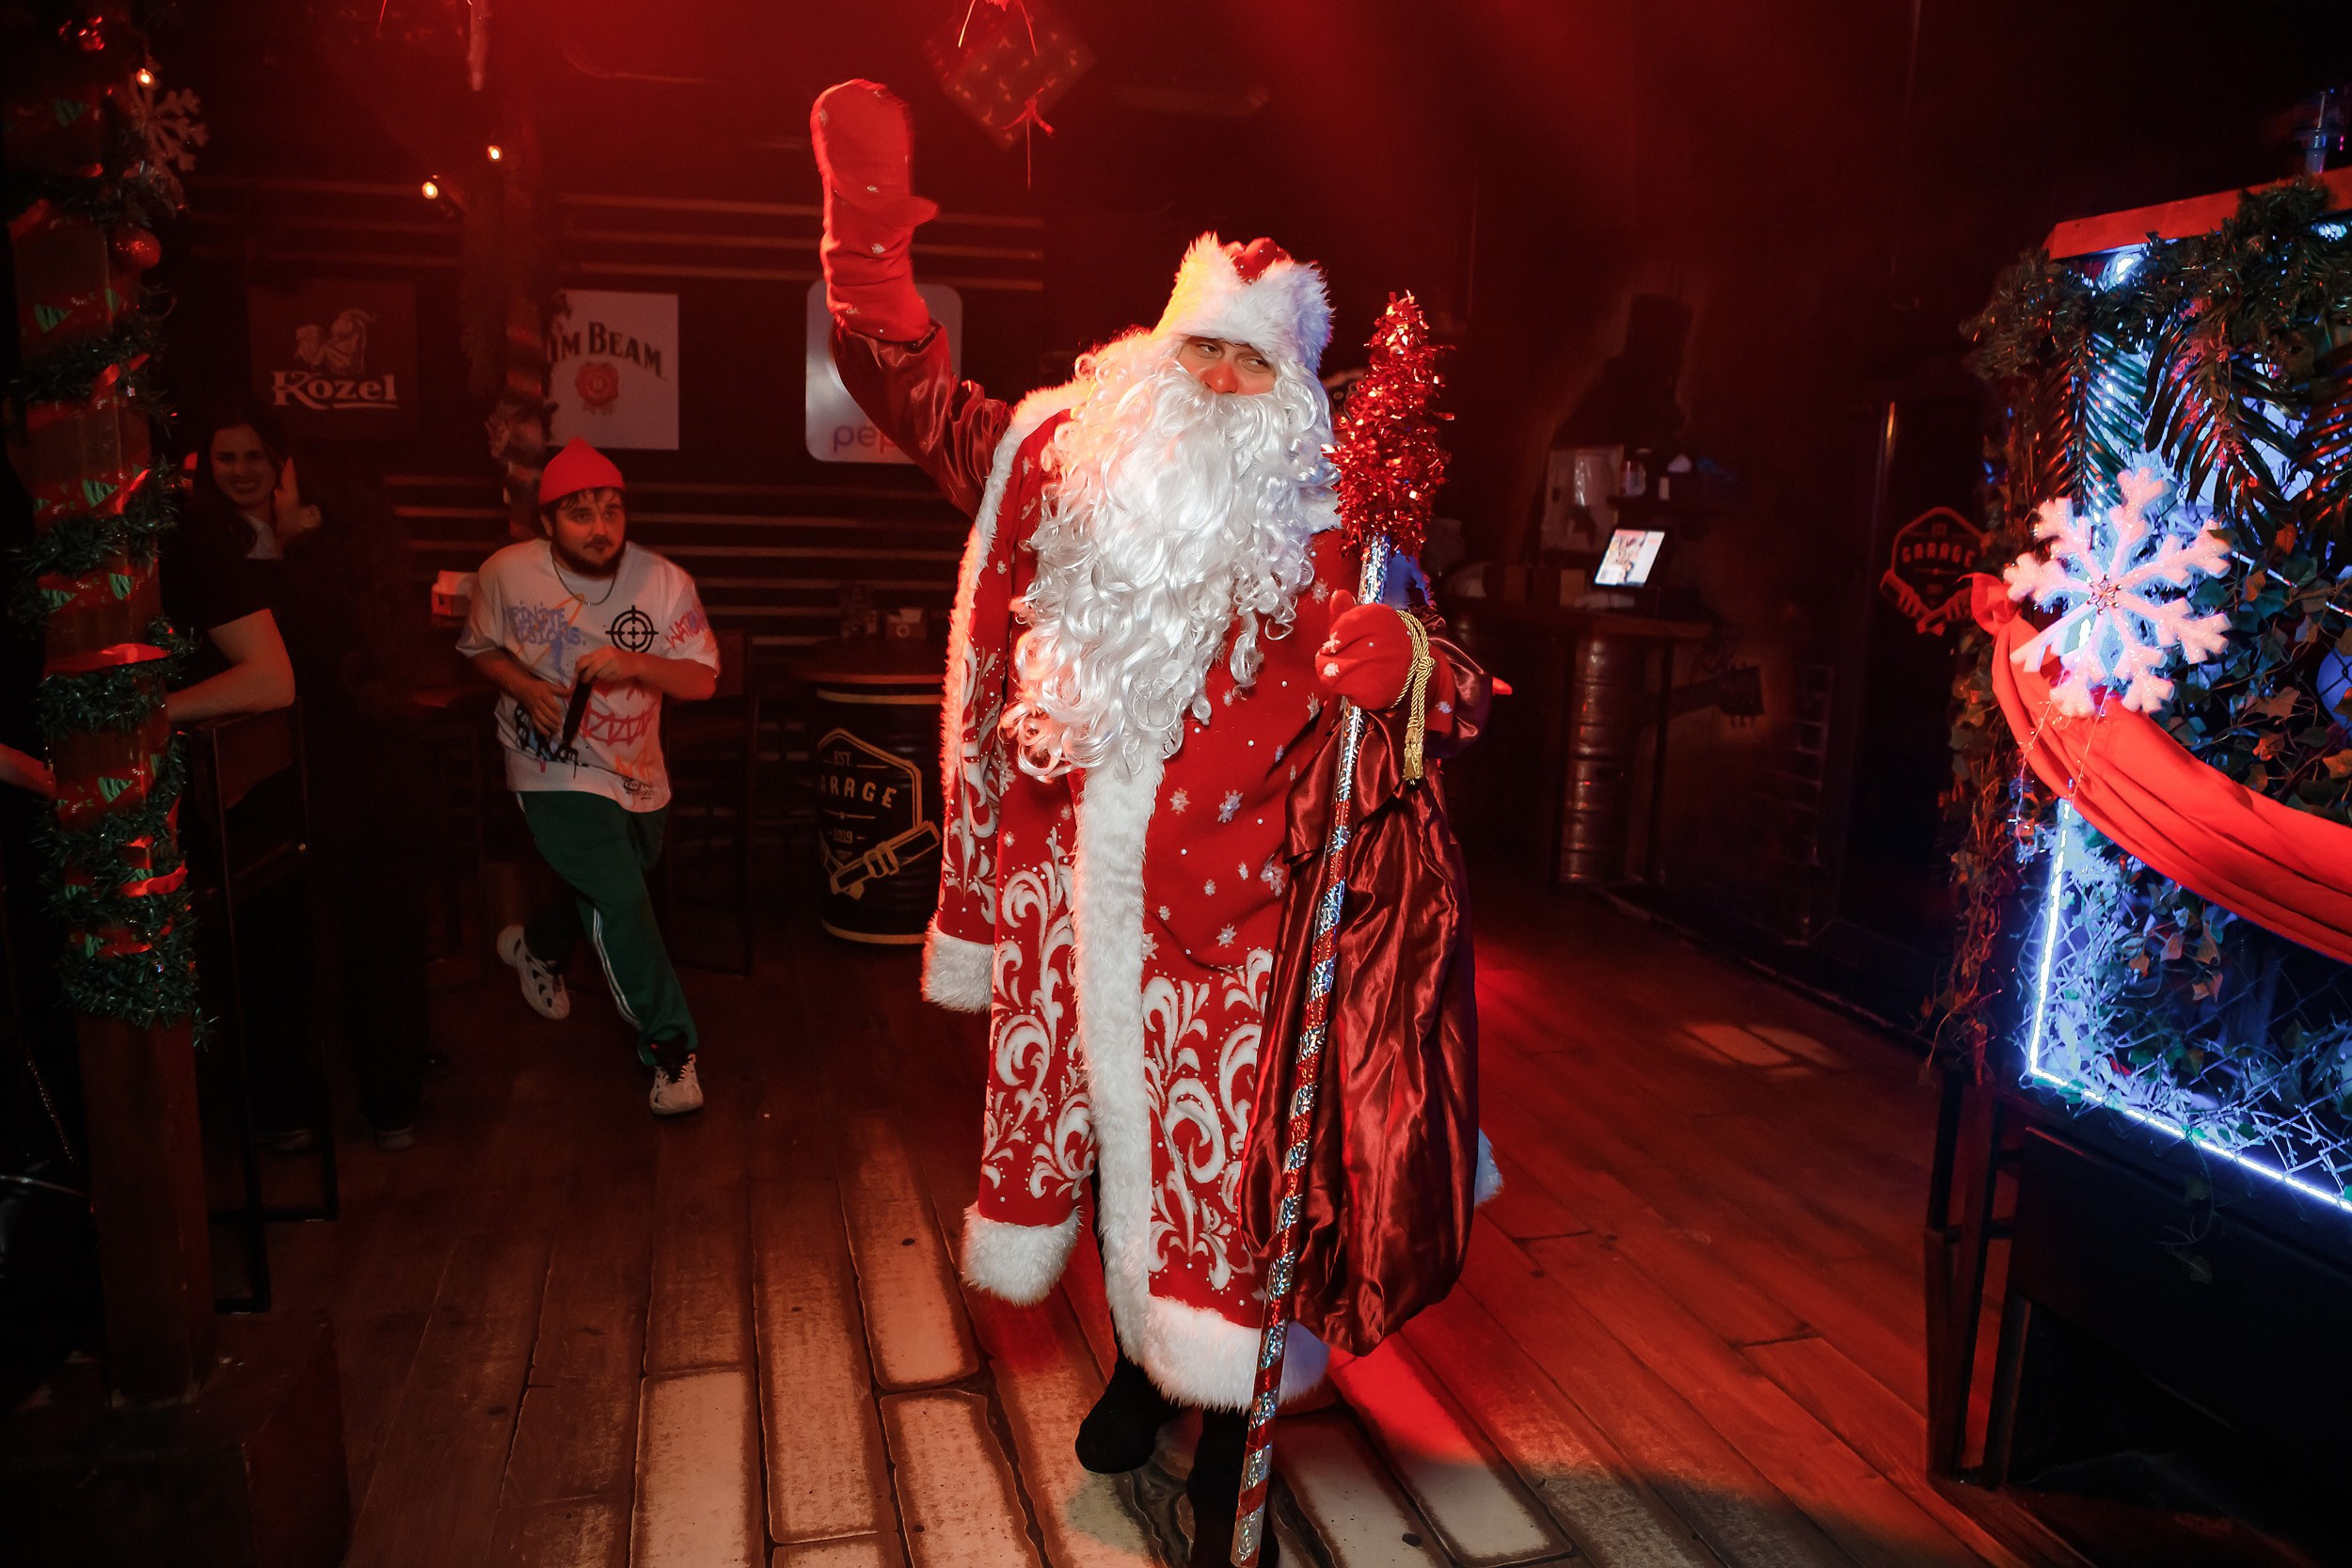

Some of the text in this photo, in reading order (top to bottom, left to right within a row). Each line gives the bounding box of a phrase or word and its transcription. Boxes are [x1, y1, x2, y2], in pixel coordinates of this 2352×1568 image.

[545, 321, 662, 379] IM BEAM
[271, 371, 397, 410] Kozel
